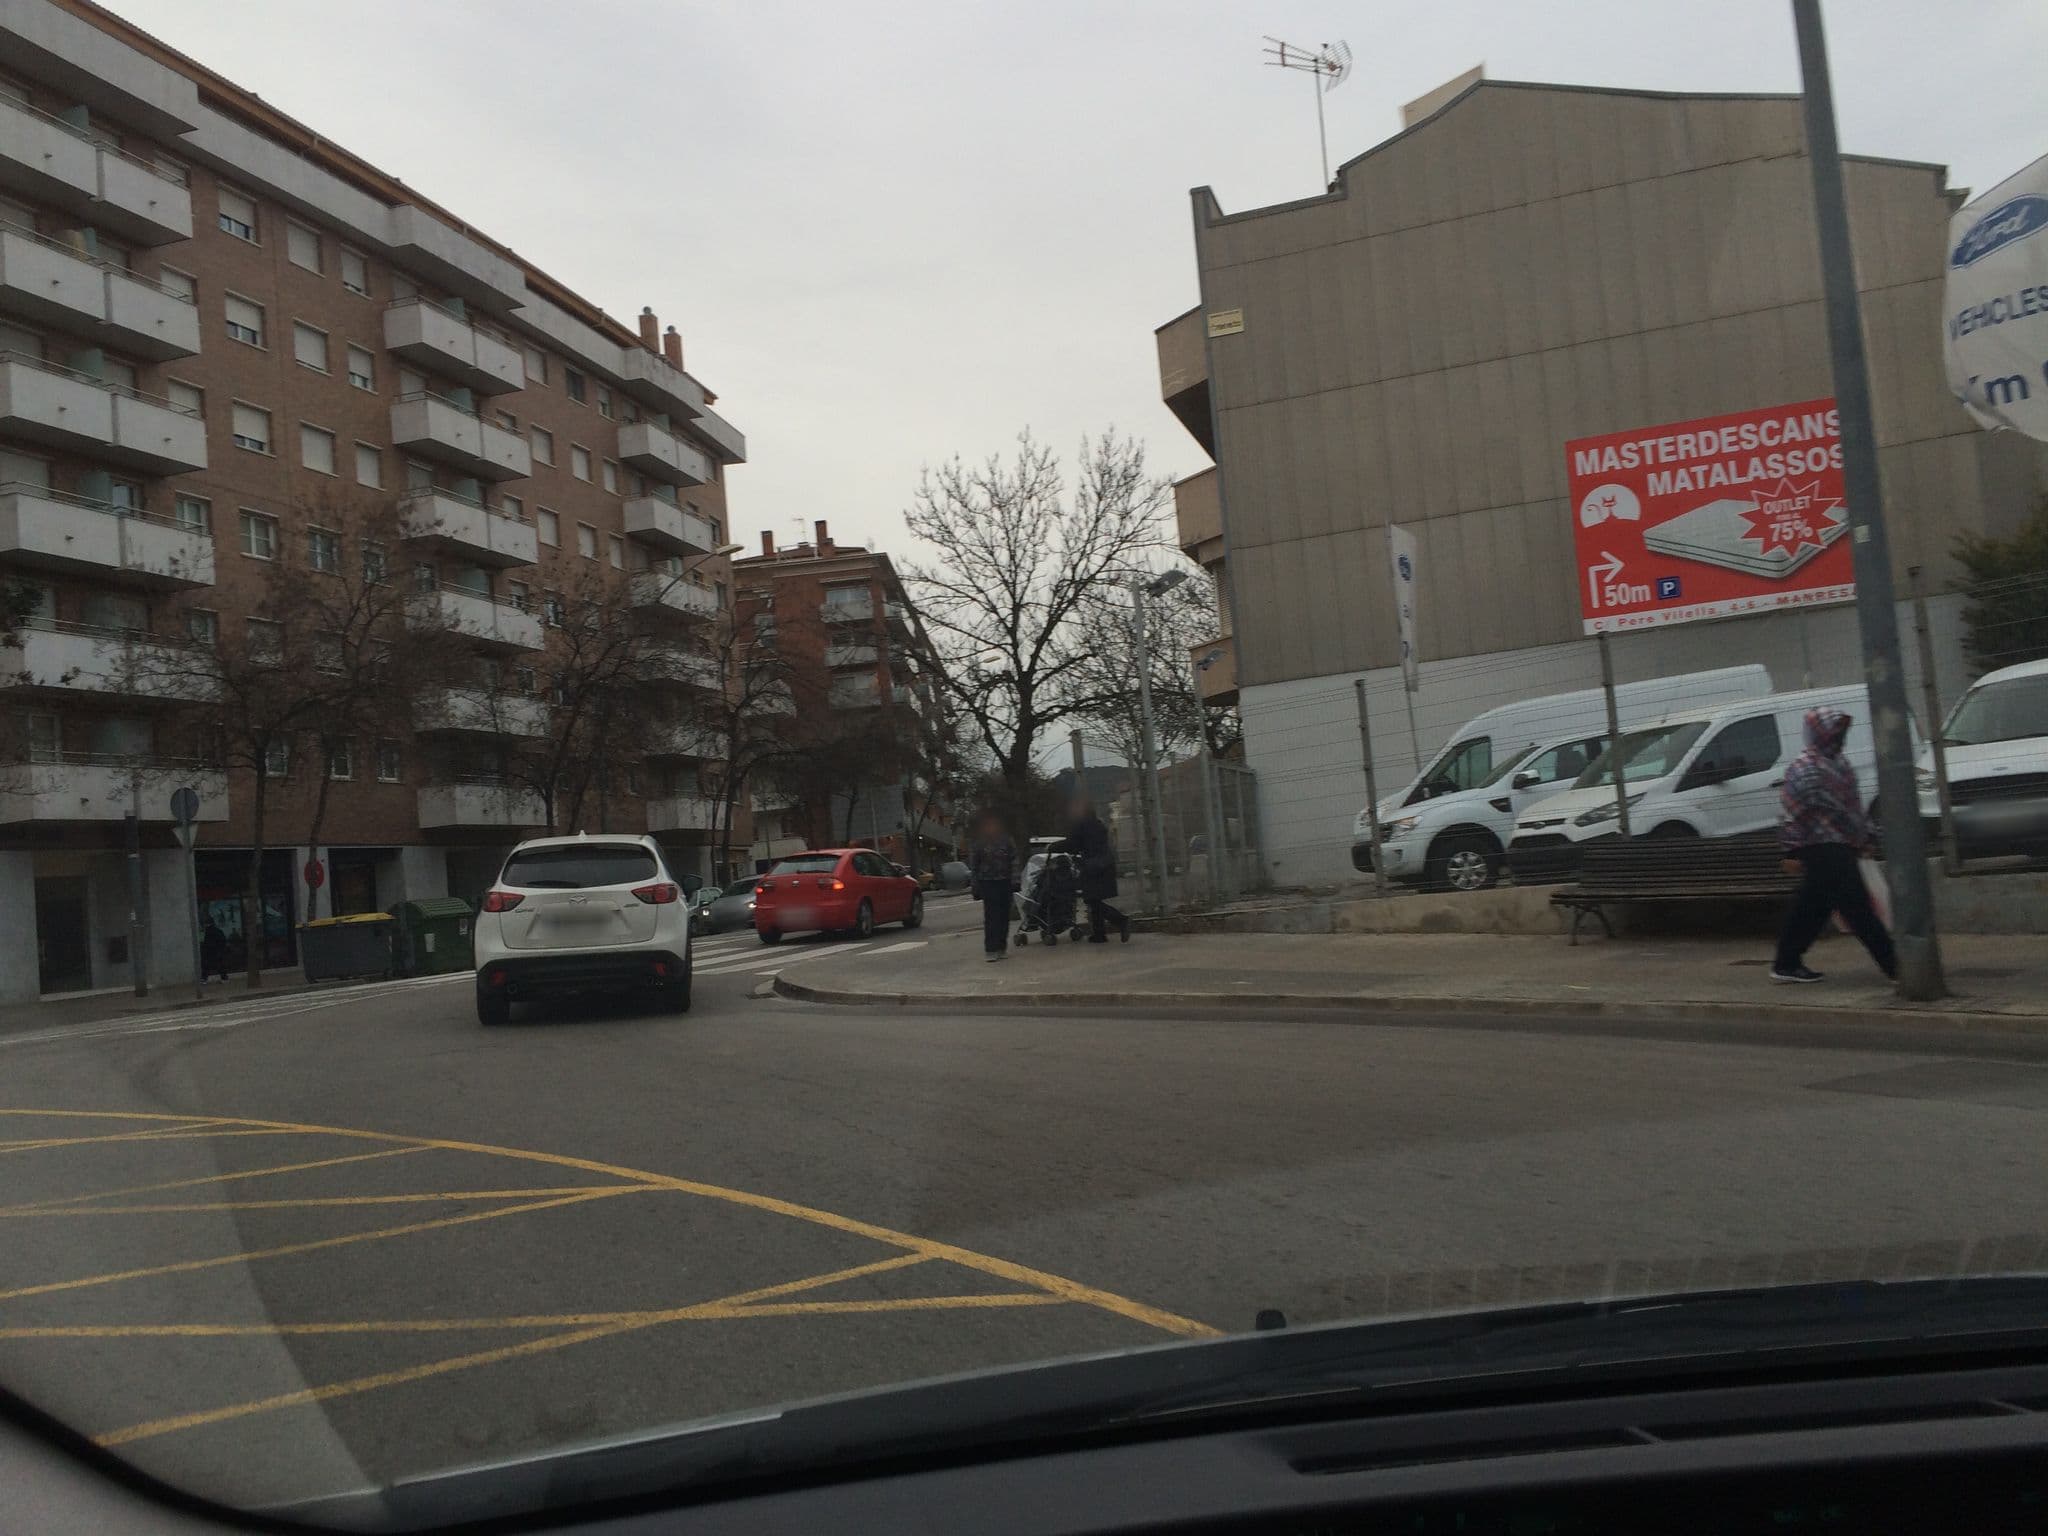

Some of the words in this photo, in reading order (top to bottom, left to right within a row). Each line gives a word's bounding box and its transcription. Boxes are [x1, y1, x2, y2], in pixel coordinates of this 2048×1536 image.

[1574, 408, 1841, 476] MASTERDESCANS
[1647, 443, 1845, 496] MATALASSOS
[1762, 495, 1811, 515] OUTLET
[1768, 518, 1814, 542] 75%
[1605, 583, 1652, 607] 50m
[1662, 581, 1676, 595] P
